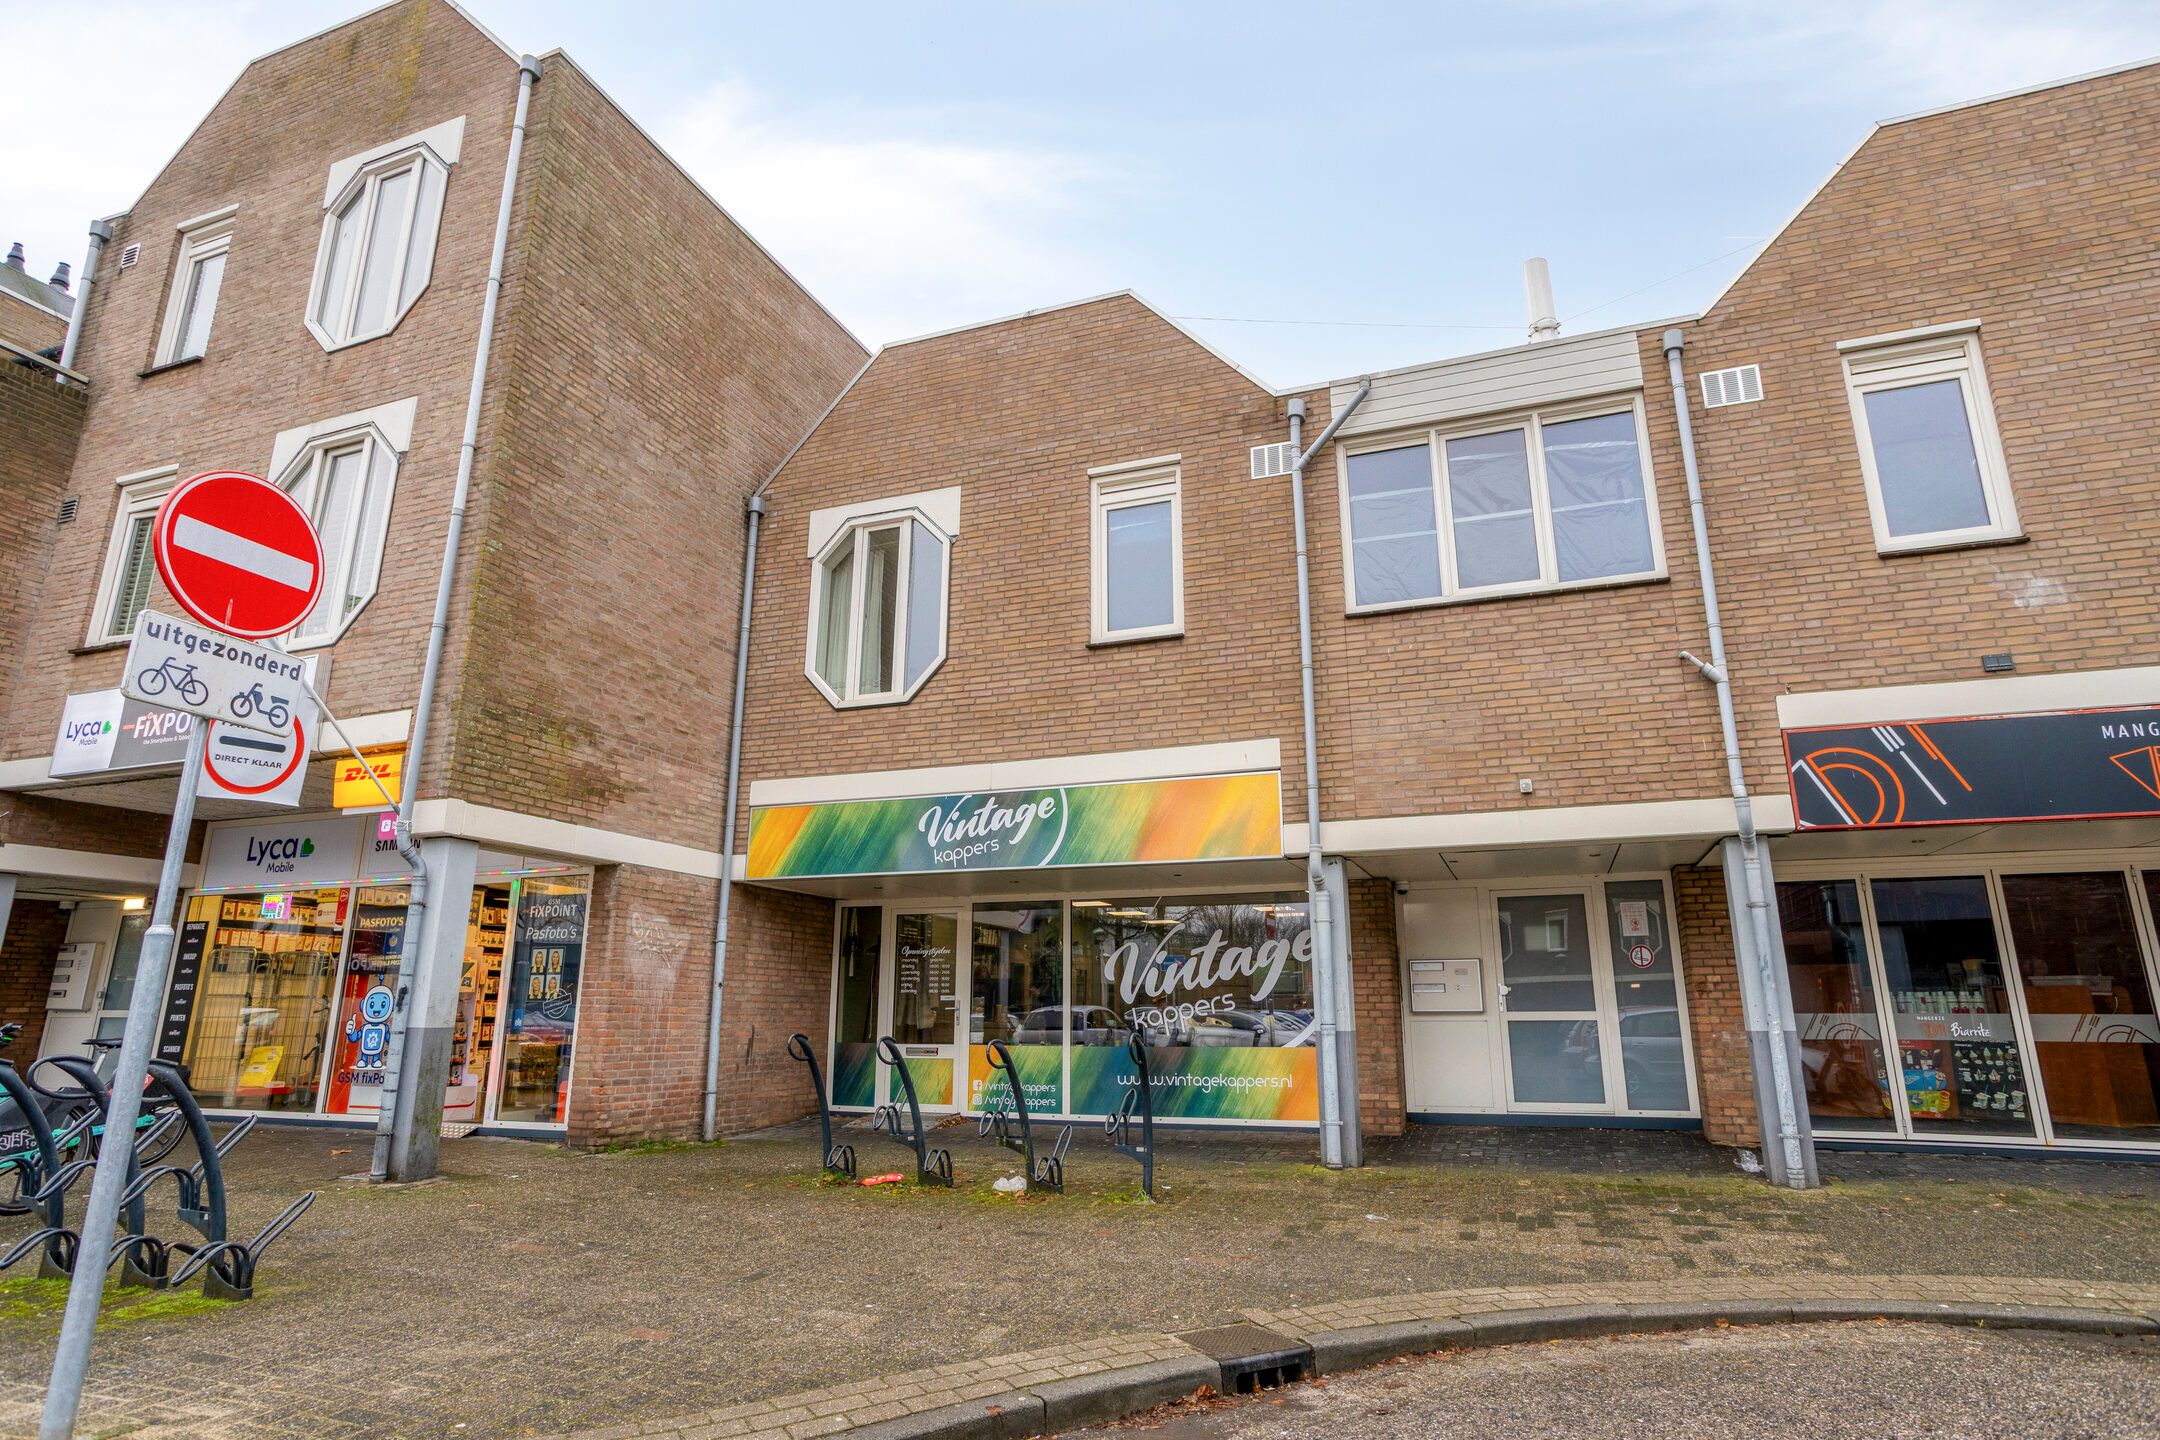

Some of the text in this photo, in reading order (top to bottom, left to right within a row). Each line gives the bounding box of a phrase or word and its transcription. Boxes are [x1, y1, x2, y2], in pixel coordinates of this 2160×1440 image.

[146, 621, 302, 682] uitgezonderd
[66, 721, 102, 741] Lyca
[133, 711, 193, 739] FiXPO
[79, 738, 98, 746] Mobile
[214, 753, 282, 769] DIRECT KLAAR
[344, 763, 392, 782] DHL
[918, 794, 1057, 848] Vintage
[247, 836, 299, 866] Lyca
[934, 838, 1000, 868] kappers
[266, 862, 295, 873] Mobile
[548, 898, 561, 906] GSM
[360, 916, 404, 928] PASFOTO'S
[525, 925, 578, 940] Pasfoto's
[1104, 922, 1313, 1005] Vintage
[1132, 992, 1236, 1037] kappers
[1950, 1021, 1991, 1037] Biarritz
[338, 1071, 385, 1085] GSM fixPo
